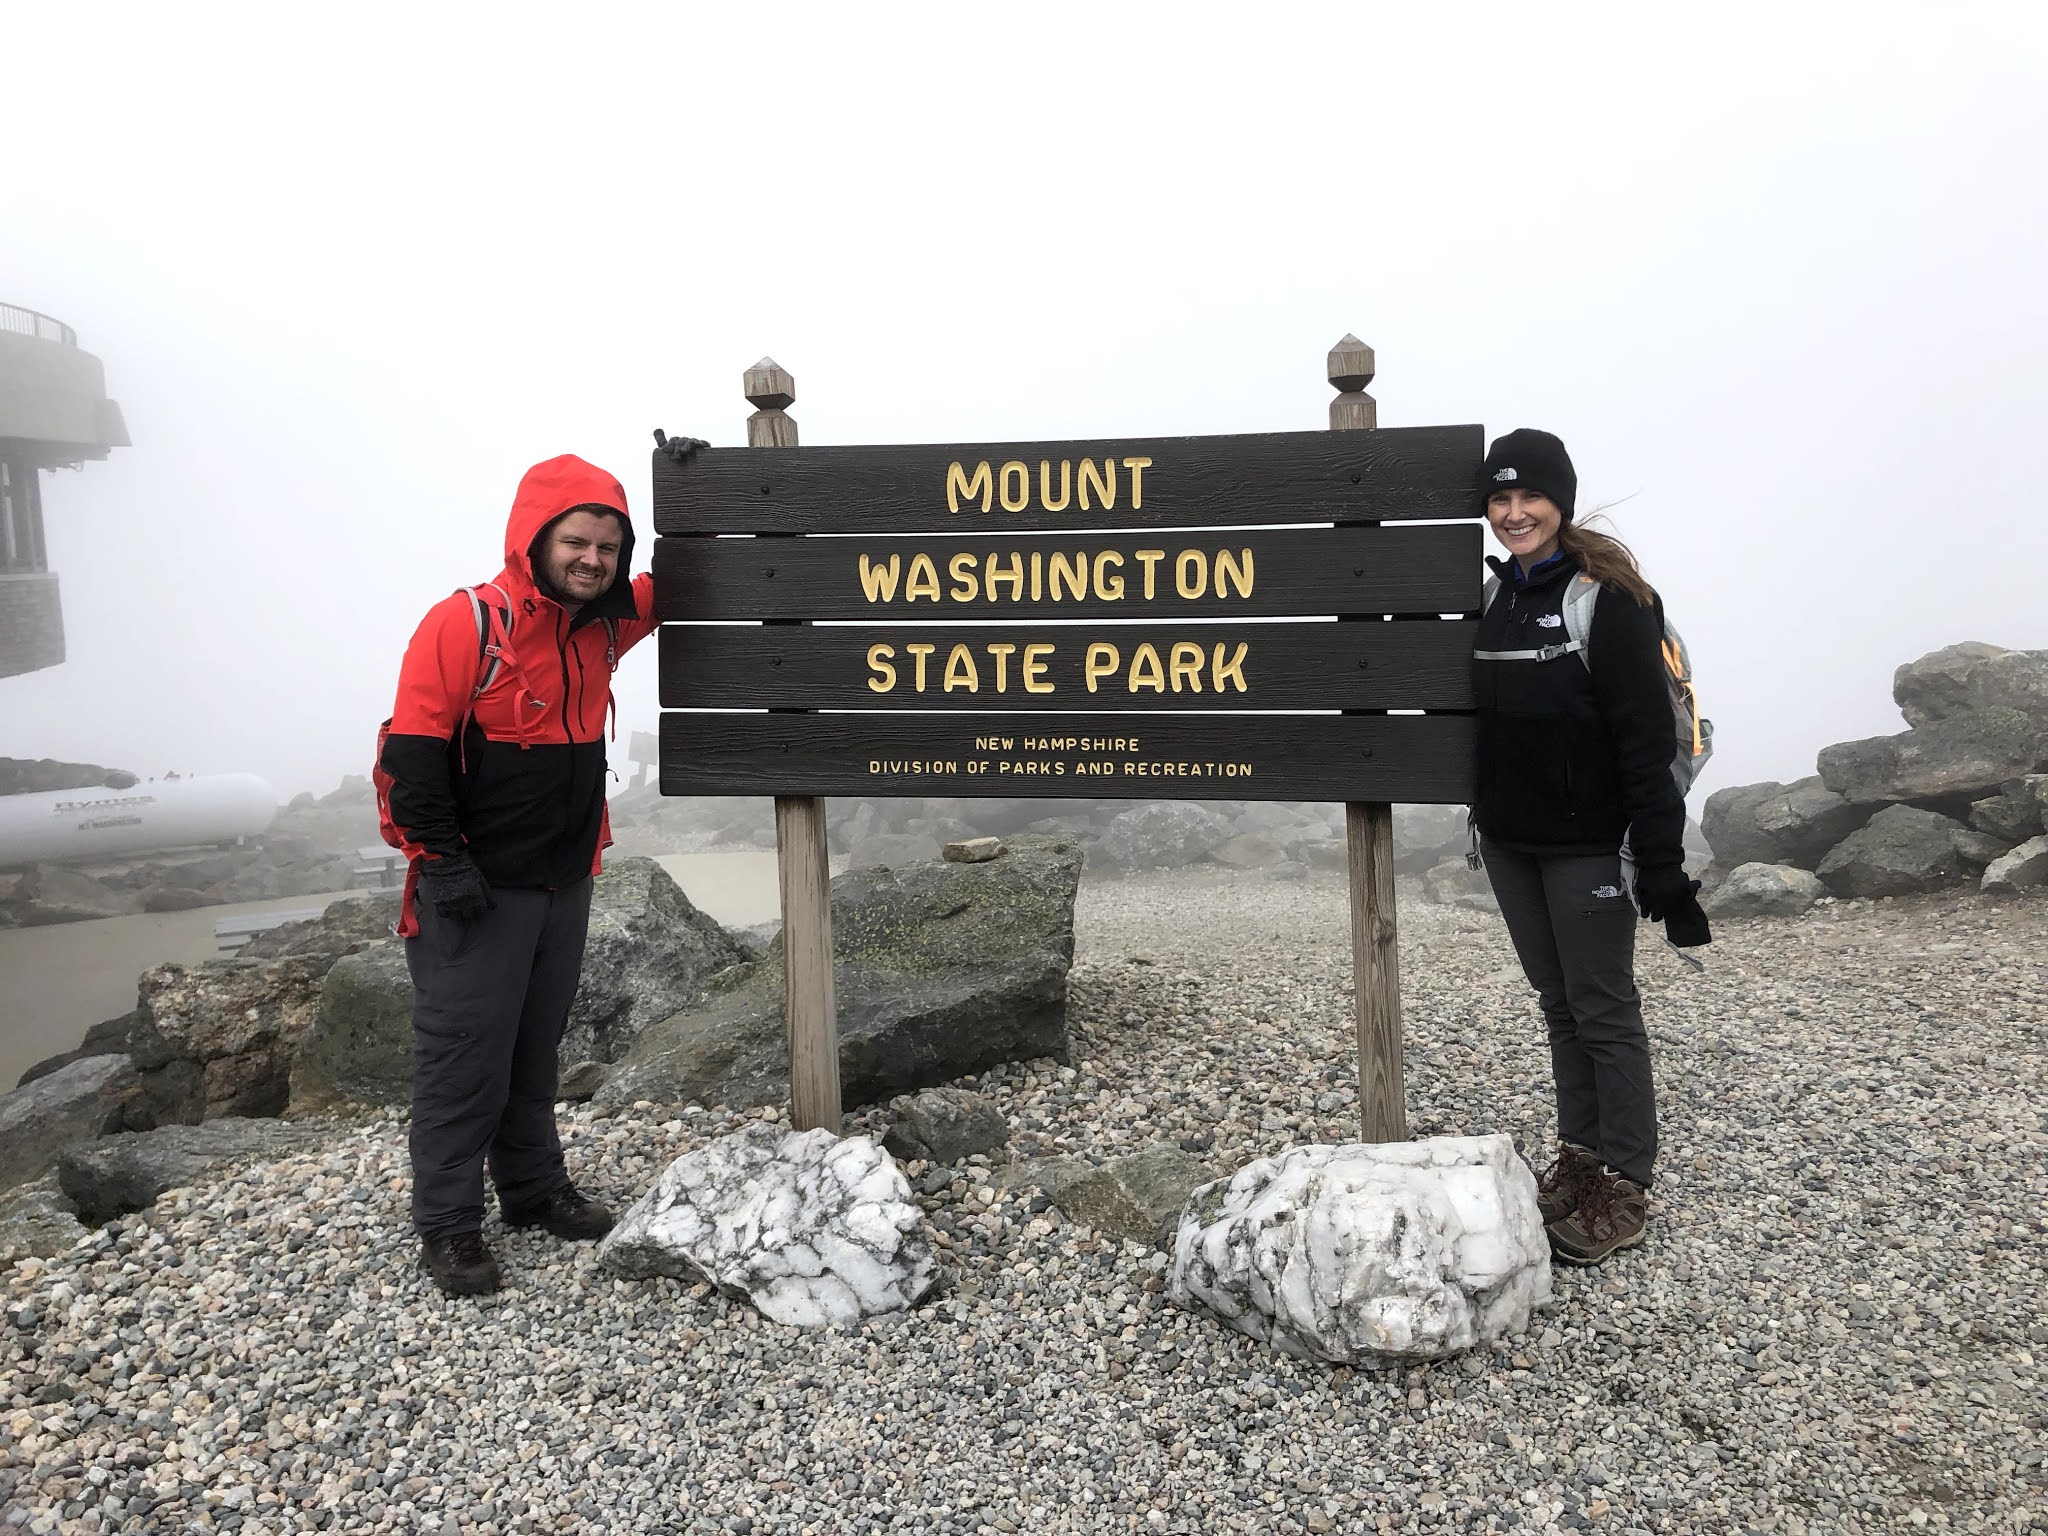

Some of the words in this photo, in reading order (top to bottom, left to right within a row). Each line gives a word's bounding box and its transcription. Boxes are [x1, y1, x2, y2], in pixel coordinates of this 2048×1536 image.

[946, 456, 1152, 513] MOUNT
[858, 548, 1255, 602] WASHINGTON
[867, 643, 1055, 694] STATE
[1085, 641, 1249, 694] PARK
[869, 761, 957, 774] DIVISION
[967, 761, 988, 775] OF
[999, 761, 1065, 775] PARKS
[1075, 762, 1115, 776] AND
[1124, 762, 1252, 777] RECREATION
[976, 737, 1013, 751] NEW
[1025, 737, 1138, 752] HAMPSHIRE
